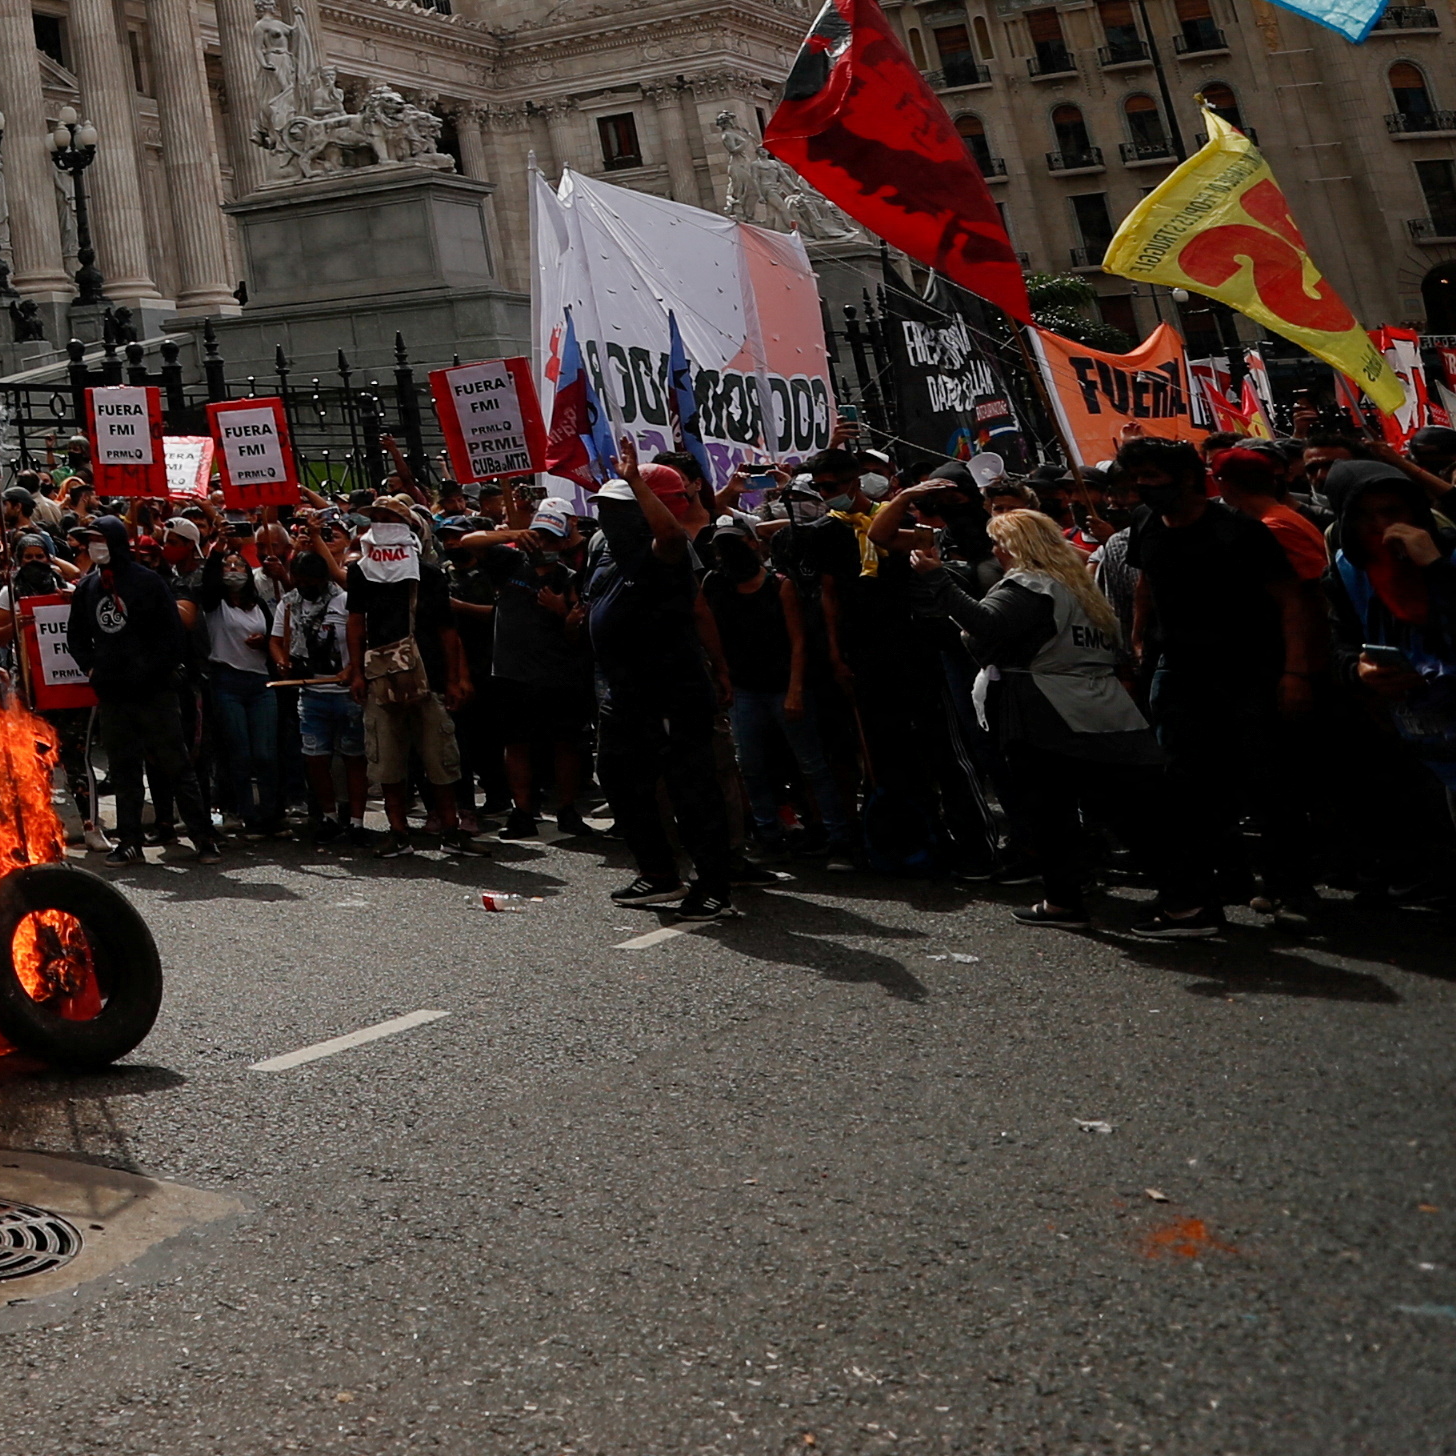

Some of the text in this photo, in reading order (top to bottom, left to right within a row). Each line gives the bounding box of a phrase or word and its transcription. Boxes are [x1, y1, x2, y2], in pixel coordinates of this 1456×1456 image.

[454, 377, 506, 397] FUERA
[98, 404, 144, 416] FUERA
[470, 398, 500, 414] FMI
[109, 424, 135, 436] FMI
[224, 423, 273, 439] FUERA
[238, 443, 266, 457] FMI
[468, 436, 524, 455] PRML
[167, 463, 183, 471] MI
[39, 622, 68, 635] FUE
